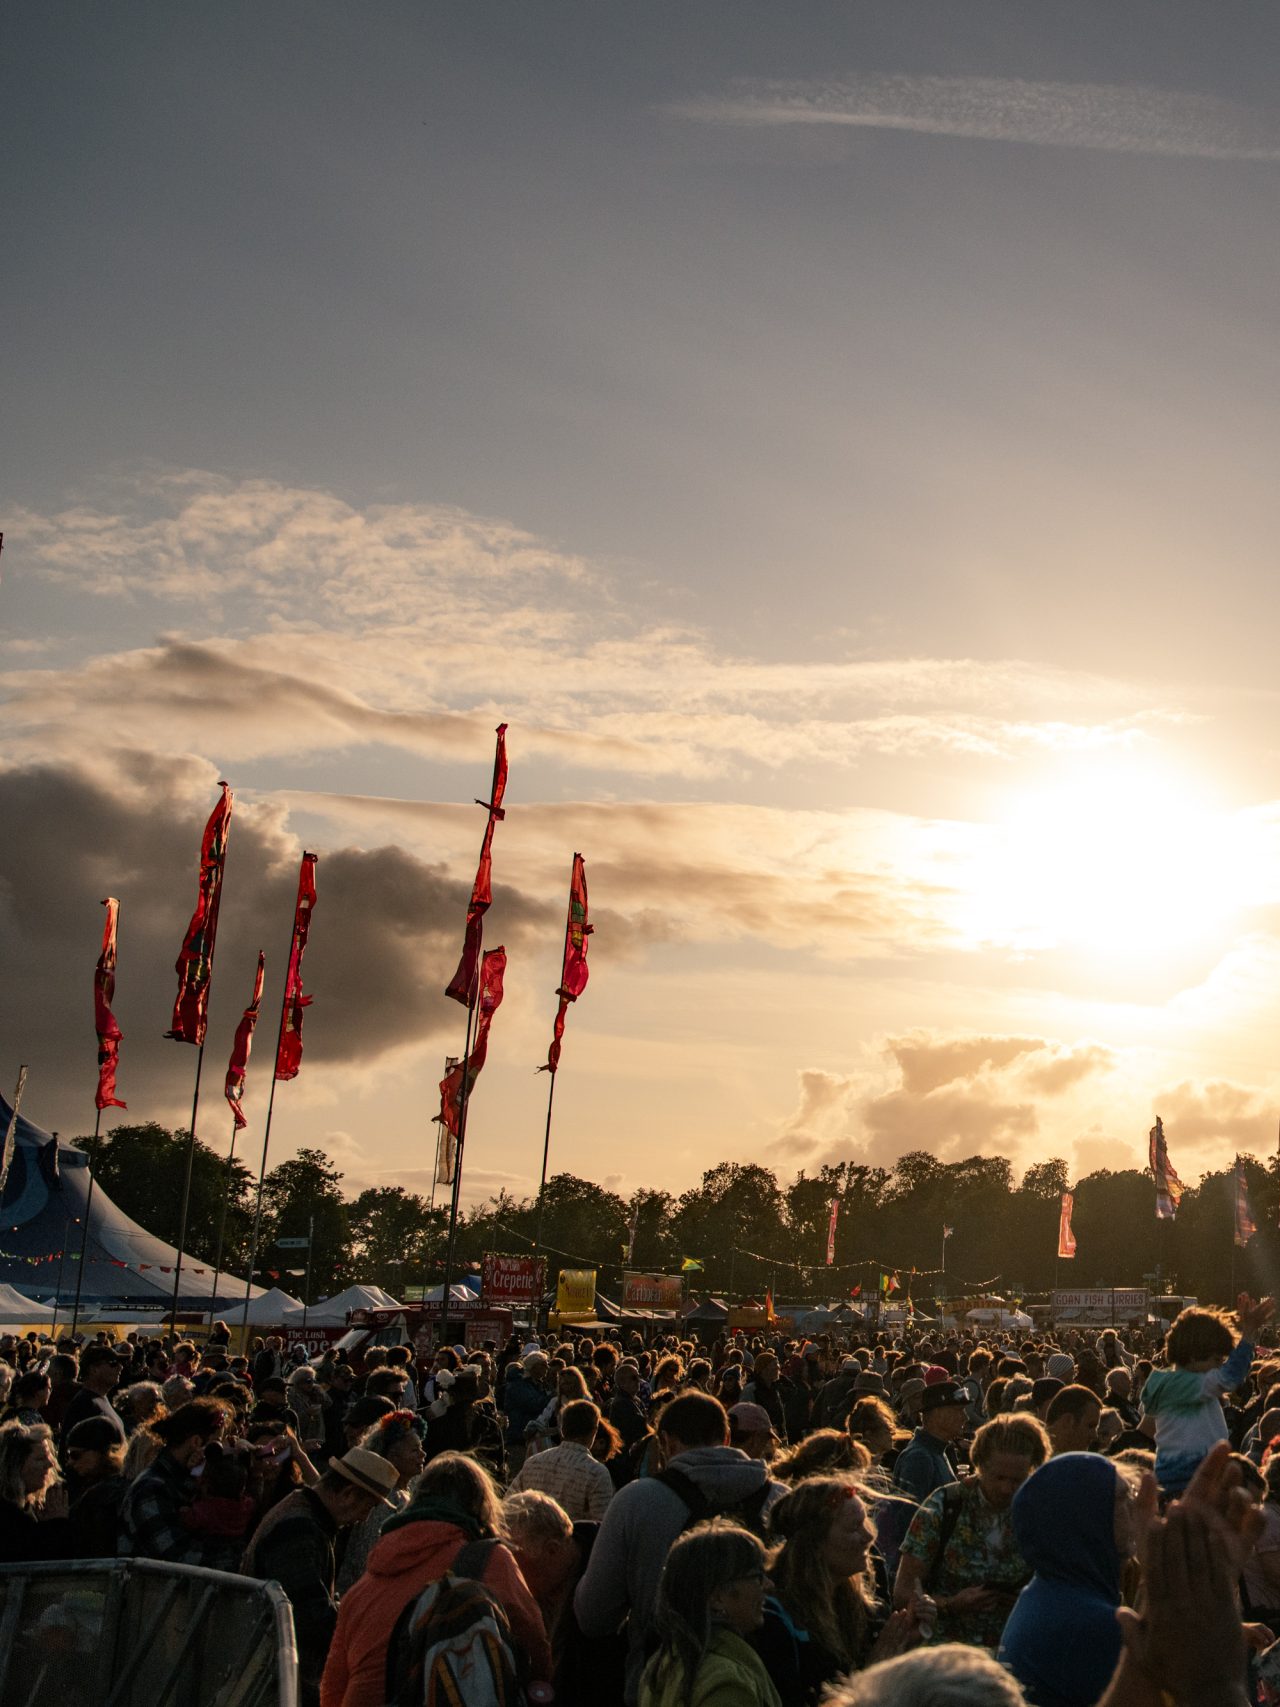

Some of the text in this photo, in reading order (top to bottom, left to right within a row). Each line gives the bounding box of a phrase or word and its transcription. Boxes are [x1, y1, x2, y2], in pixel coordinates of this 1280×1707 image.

[1056, 1294, 1144, 1305] GOAN FISH CURRIES
[430, 1302, 440, 1310] ICE
[458, 1302, 483, 1310] DRINKS
[288, 1330, 326, 1339] The Lush
